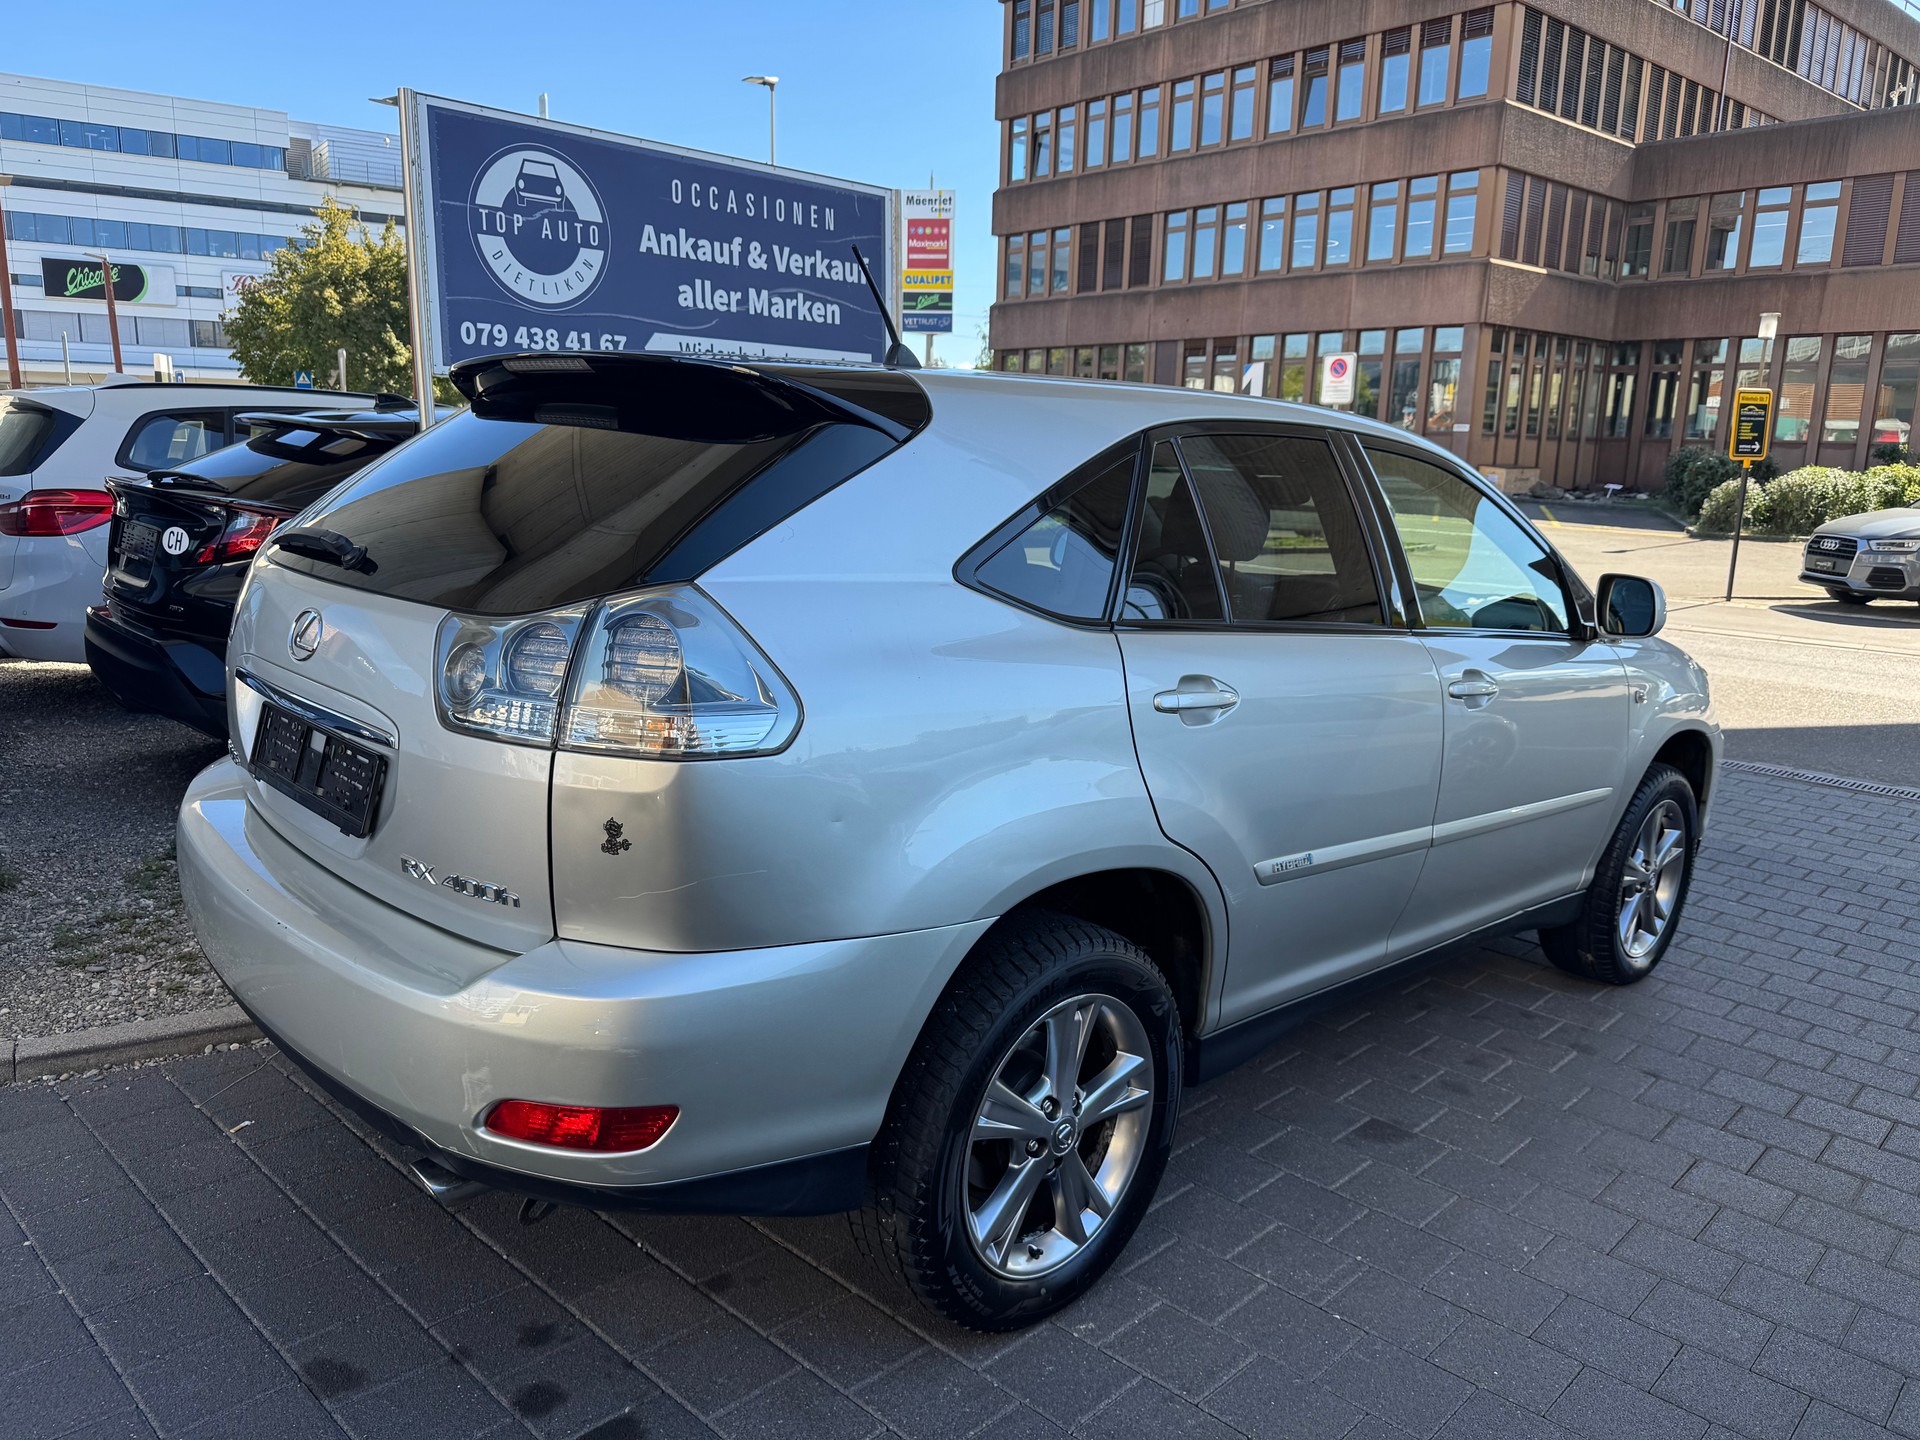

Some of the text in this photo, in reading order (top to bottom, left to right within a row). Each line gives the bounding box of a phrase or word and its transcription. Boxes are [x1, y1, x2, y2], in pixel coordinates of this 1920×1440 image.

[671, 179, 835, 231] OCCASIONEN
[479, 208, 599, 246] TOP AUTO
[492, 250, 594, 295] DIETLIKON
[639, 224, 870, 285] Ankauf & Verkauf
[905, 275, 952, 285] QUALIPET
[677, 278, 841, 325] aller Marken
[460, 321, 627, 351] 079 438 41 67
[167, 530, 184, 551] CH
[400, 854, 521, 908] RX 400h
[1271, 856, 1311, 874] HYBRID
